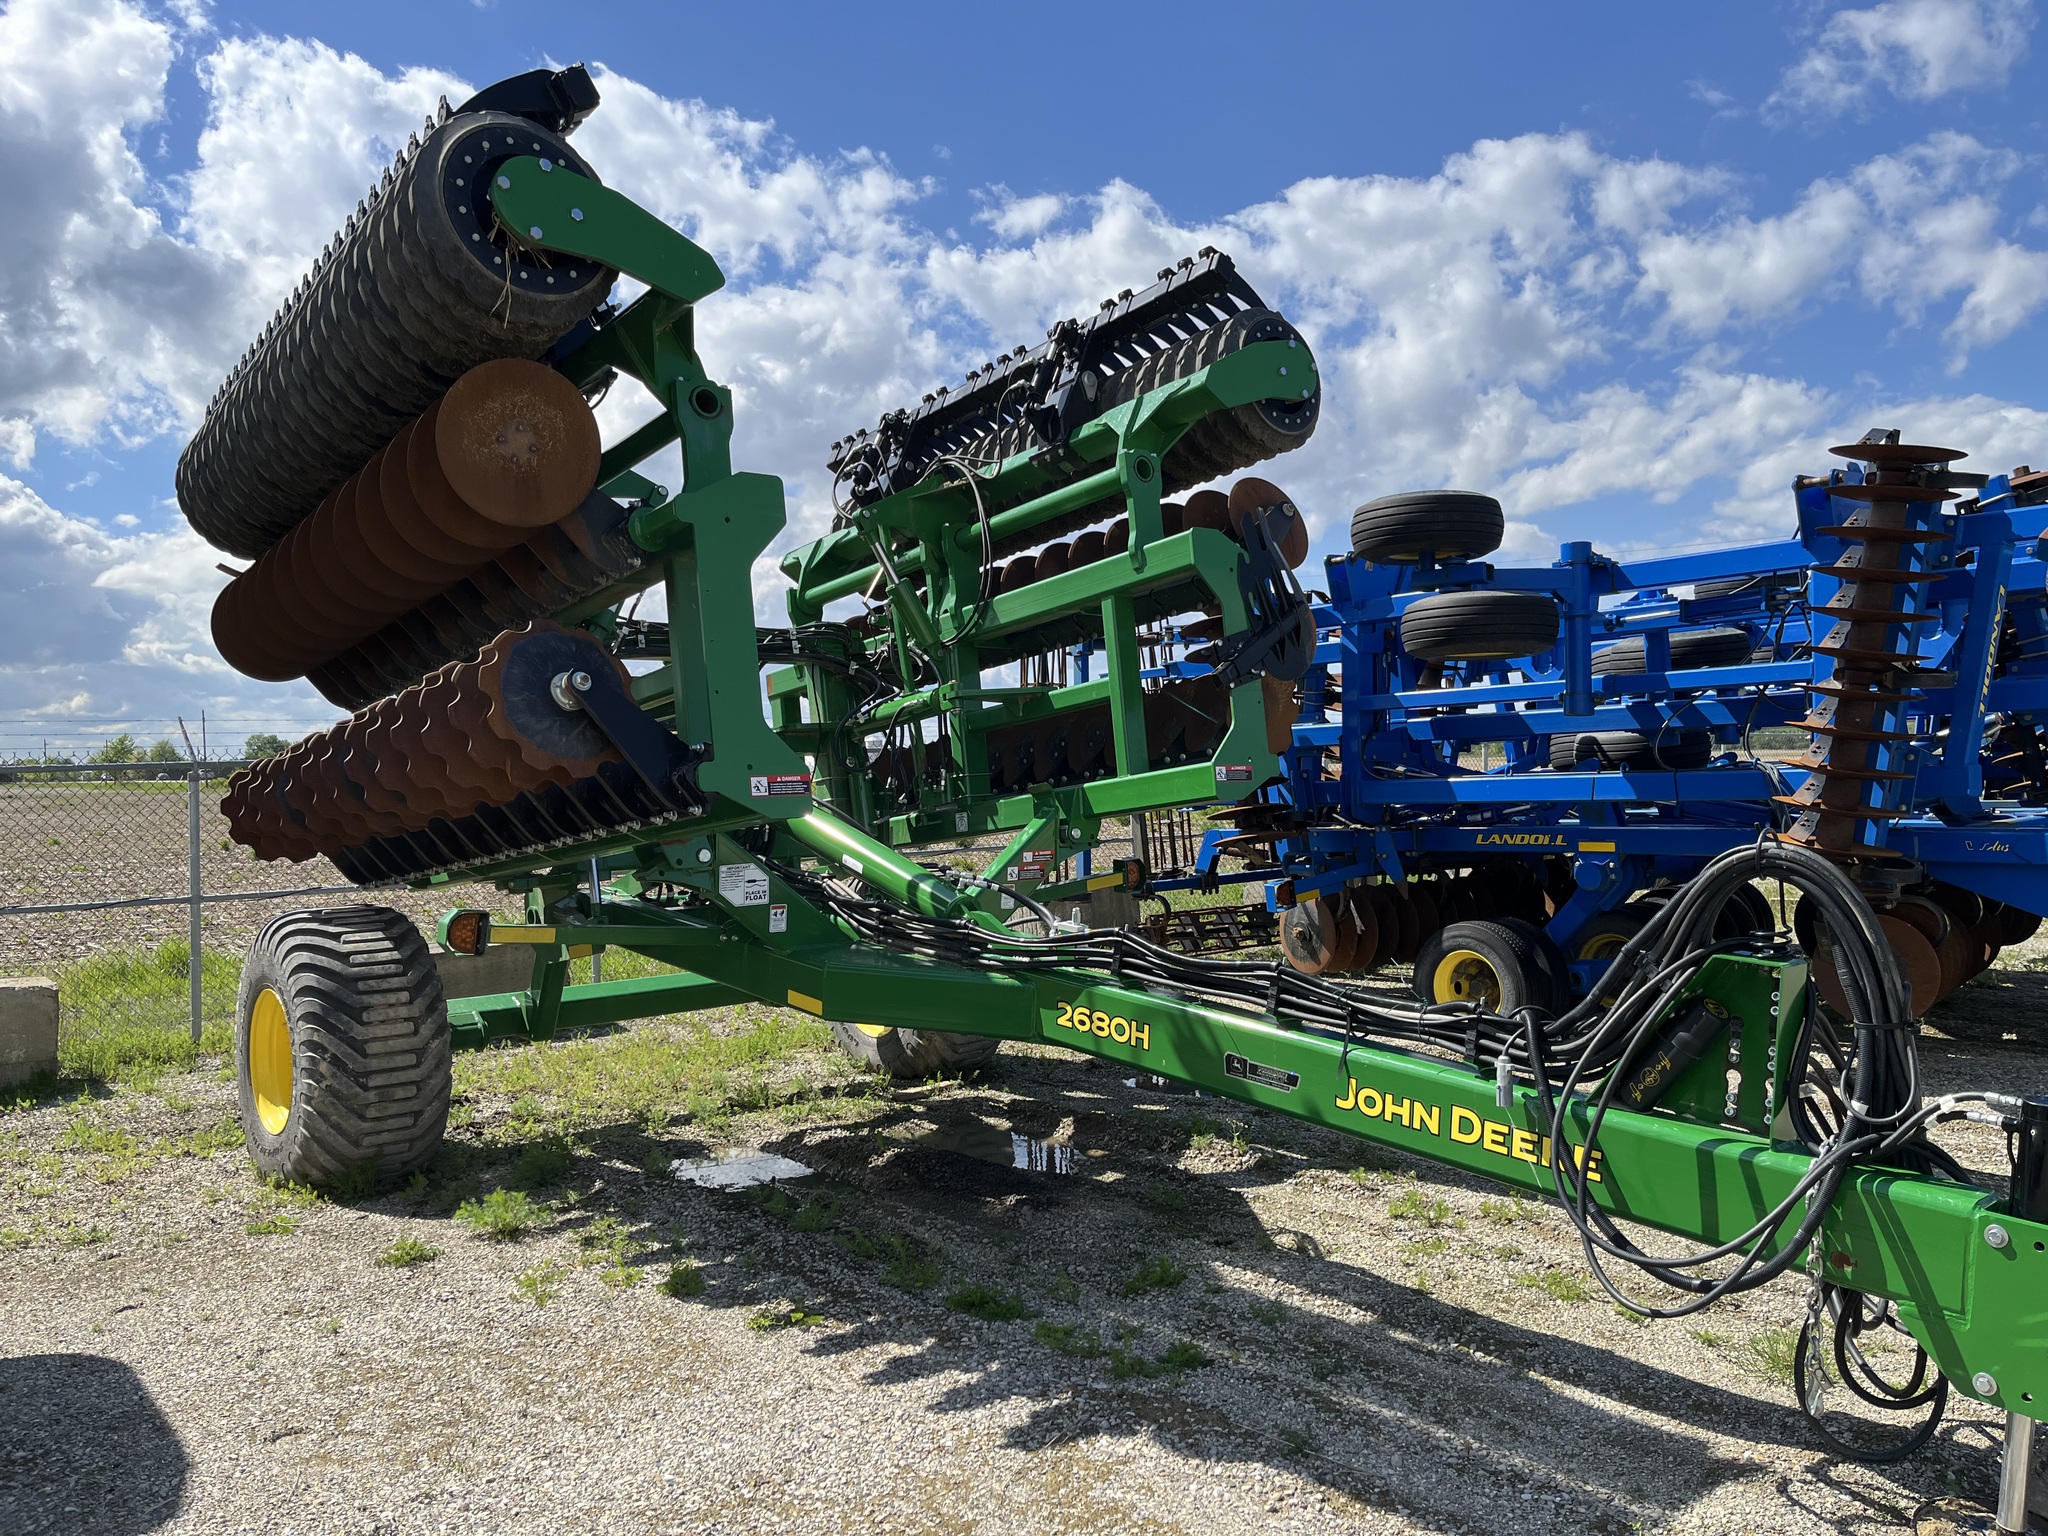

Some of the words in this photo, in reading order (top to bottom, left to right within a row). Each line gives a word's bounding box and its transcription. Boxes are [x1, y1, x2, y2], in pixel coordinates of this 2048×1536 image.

[1978, 584, 2005, 718] LANDOLL
[745, 894, 767, 902] FLOAT
[1056, 1001, 1151, 1051] 2680H
[1334, 1076, 1442, 1137] JOHN
